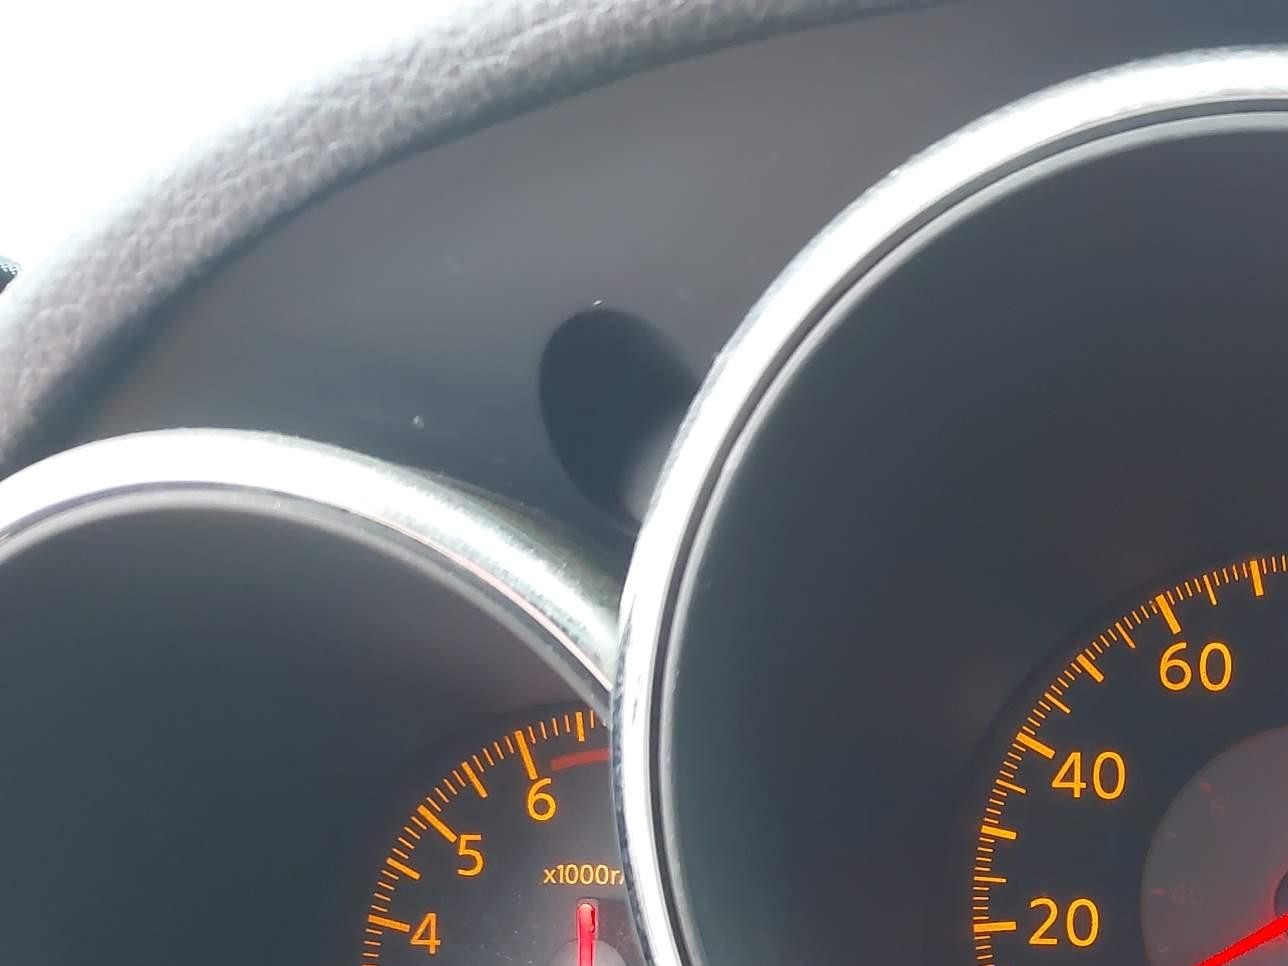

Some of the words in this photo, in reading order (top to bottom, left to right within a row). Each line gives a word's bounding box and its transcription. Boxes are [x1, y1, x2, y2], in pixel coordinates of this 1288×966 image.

[1159, 642, 1234, 692] 60
[1051, 751, 1127, 800] 40
[527, 777, 557, 821] 6
[456, 834, 484, 876] 5
[410, 912, 441, 954] 4
[1029, 898, 1100, 947] 20
